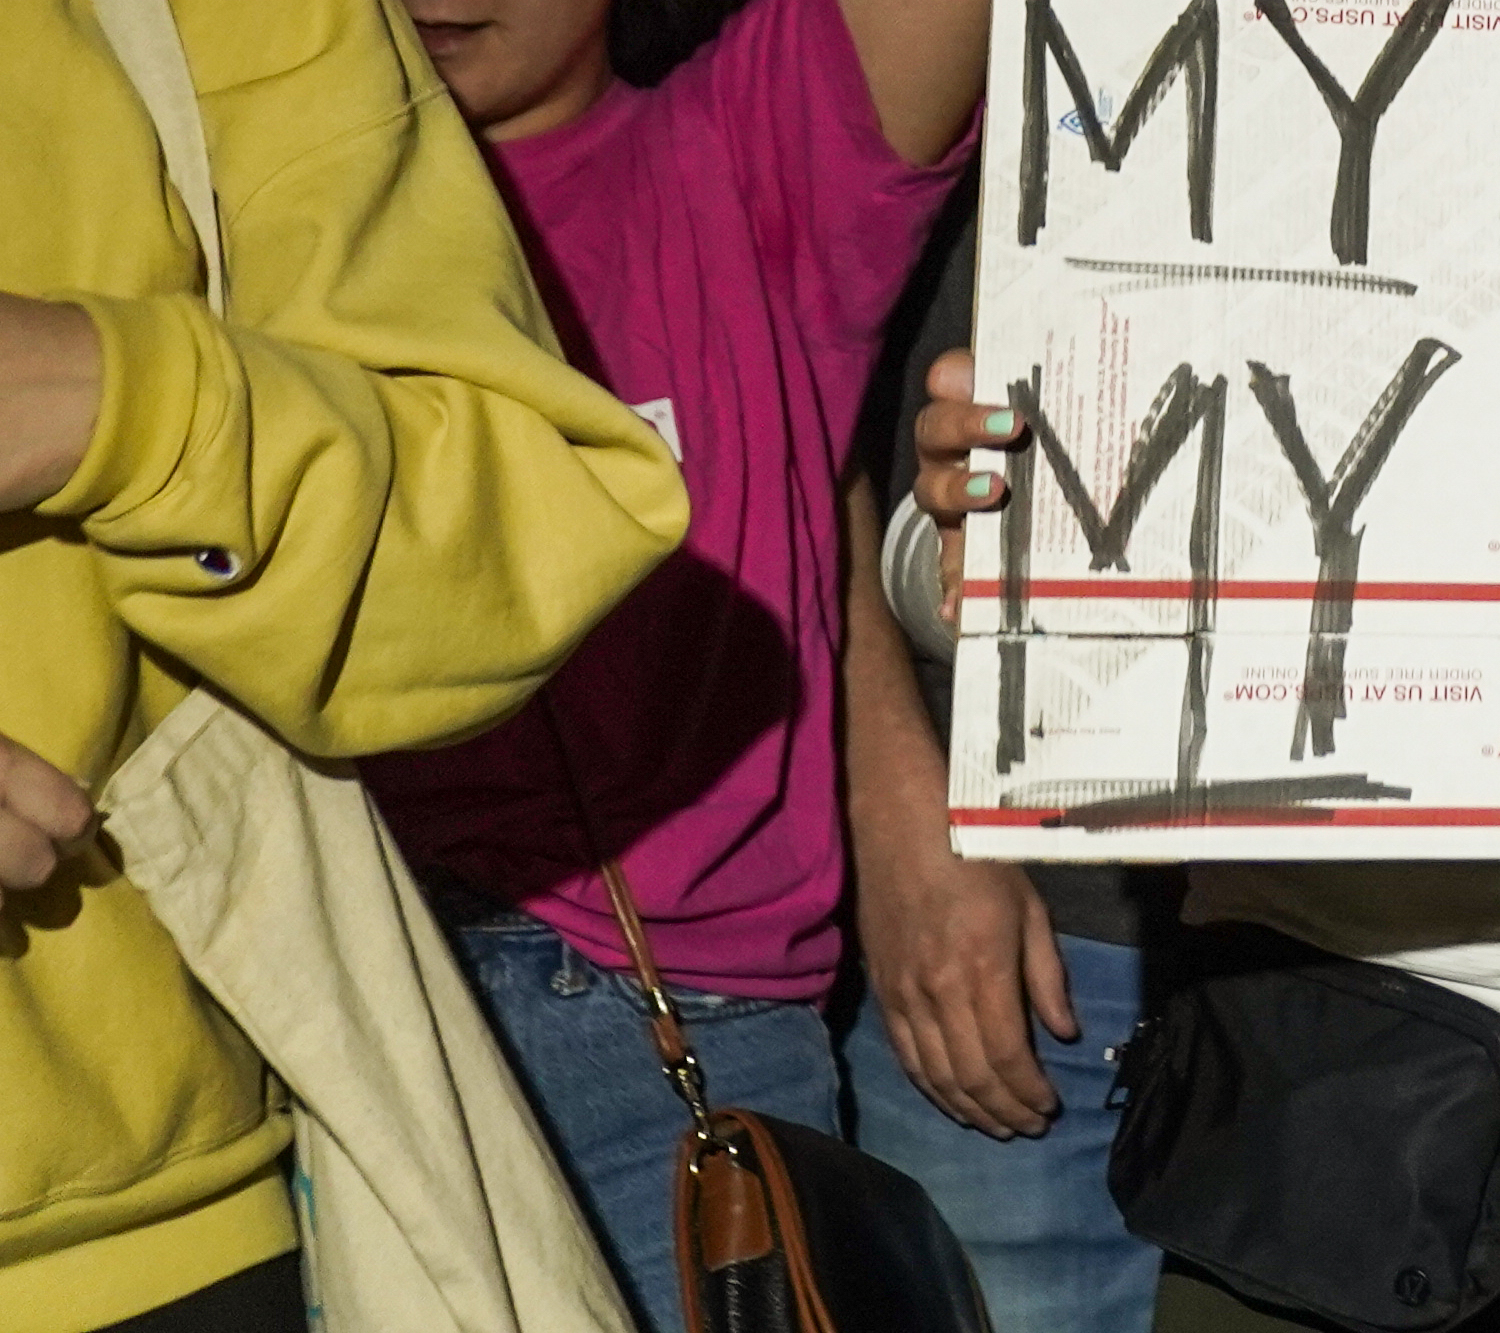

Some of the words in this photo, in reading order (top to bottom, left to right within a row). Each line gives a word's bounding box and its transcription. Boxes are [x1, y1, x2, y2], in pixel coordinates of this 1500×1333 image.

[996, 337, 1462, 783] MY
[1361, 685, 1389, 702] AT
[1394, 685, 1422, 702] US
[1430, 685, 1483, 702] VISIT
